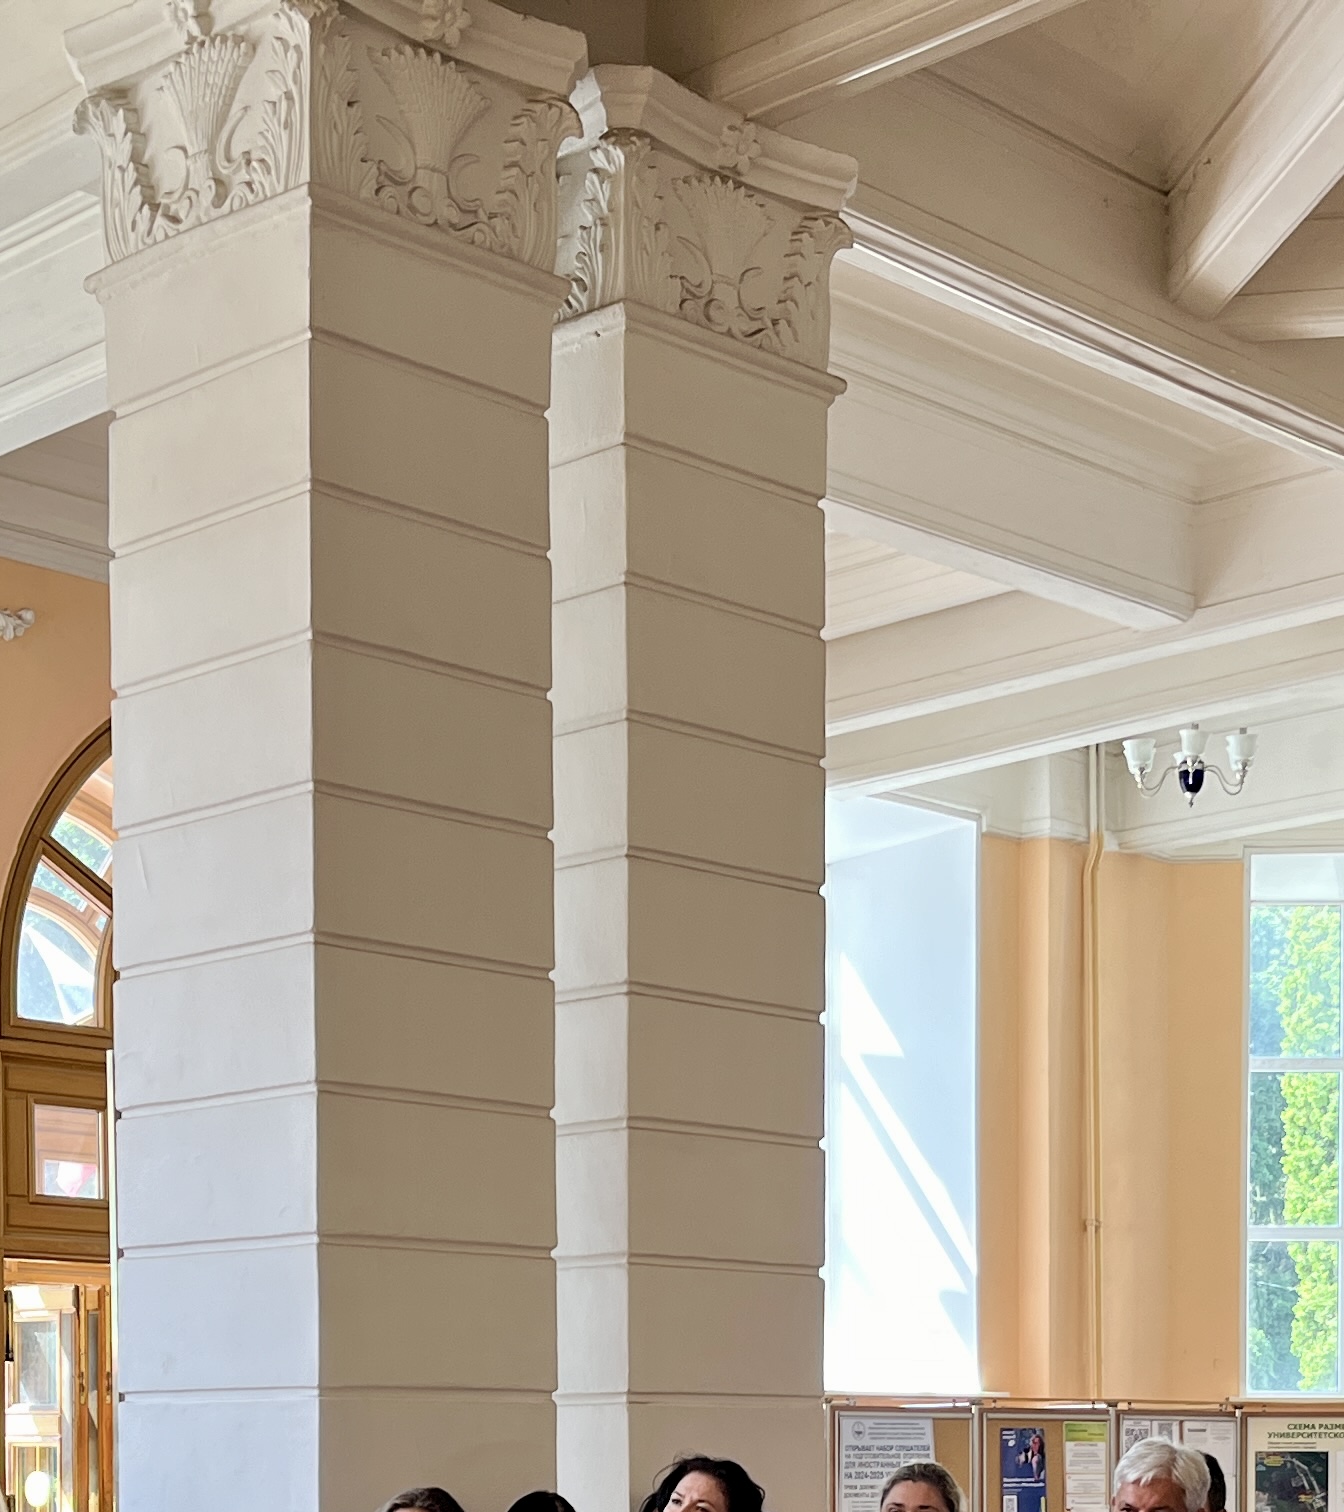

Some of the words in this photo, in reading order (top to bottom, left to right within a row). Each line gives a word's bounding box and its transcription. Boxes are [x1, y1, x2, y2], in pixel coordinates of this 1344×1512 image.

[1287, 1423, 1316, 1431] СХЕМА
[844, 1471, 853, 1480] НА
[854, 1471, 885, 1480] 2024-2025
